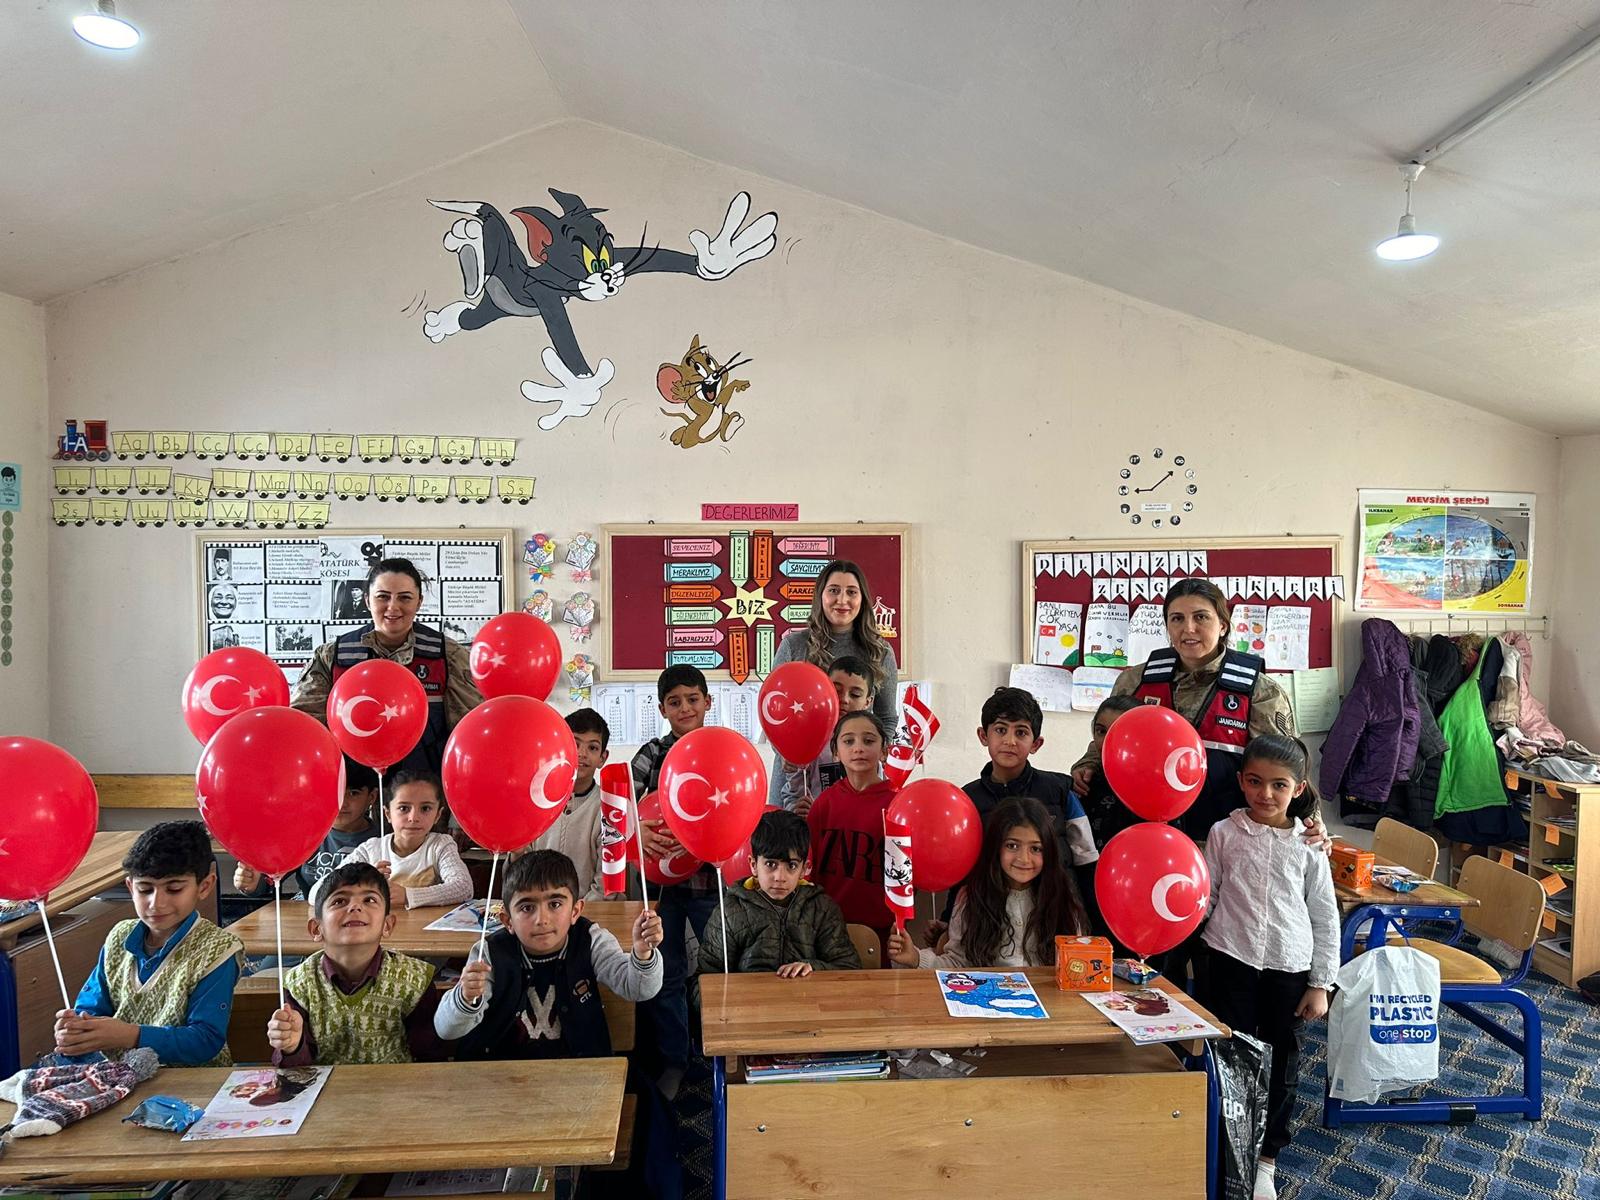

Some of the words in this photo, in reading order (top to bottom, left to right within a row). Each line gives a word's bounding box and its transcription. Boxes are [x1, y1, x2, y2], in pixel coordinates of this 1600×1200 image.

[63, 436, 88, 452] 1-A
[119, 434, 142, 450] Aa
[162, 436, 180, 450] Bb
[202, 436, 223, 451] Cc
[285, 437, 303, 452] Dd
[323, 436, 345, 453] Ee
[367, 439, 385, 454] Ff
[405, 439, 425, 455] Gg
[487, 442, 508, 457] Hh
[184, 477, 203, 496] Kk
[261, 474, 286, 490] Mm
[301, 473, 323, 491] Nn
[342, 476, 363, 492] Oo
[422, 479, 437, 495] Pp
[464, 479, 481, 495] Rr
[506, 479, 525, 496] Ss
[100, 501, 118, 517] Tt
[221, 503, 243, 518] Vv
[262, 504, 280, 520] Yy
[298, 505, 322, 520] Zz
[1098, 578, 1336, 594] ZENGİKLERİ
[1218, 717, 1247, 730] JANDARMA
[1369, 994, 1385, 1004] I'M
[1387, 994, 1432, 1004] RECYCLED
[1369, 1006, 1434, 1021] PLASTIC
[1378, 1029, 1399, 1039] one
[1402, 1027, 1432, 1041] stop
